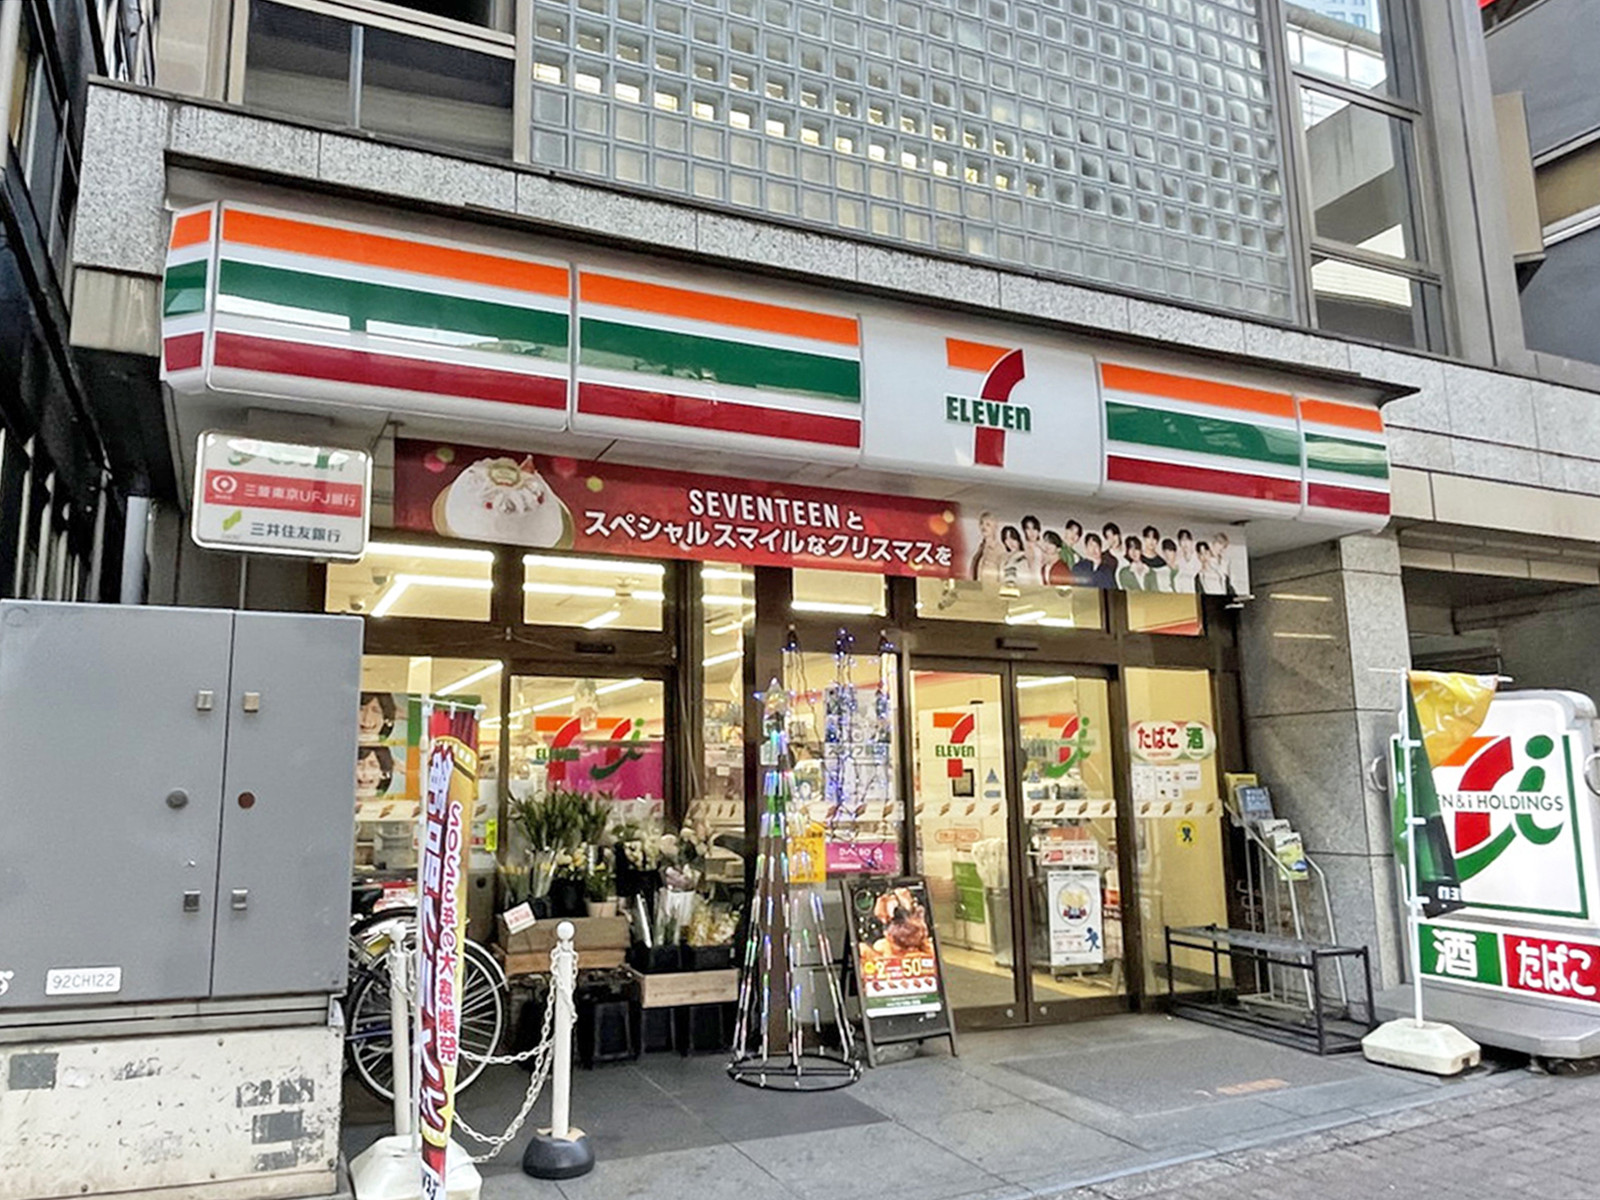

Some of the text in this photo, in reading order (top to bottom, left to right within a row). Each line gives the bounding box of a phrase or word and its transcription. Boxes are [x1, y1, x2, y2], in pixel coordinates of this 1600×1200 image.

[244, 482, 357, 508] 三菱東京UFJ銀行
[250, 521, 343, 544] 三井住友銀行
[584, 510, 952, 567] スペシャルスマイルなクリスマスを
[1137, 726, 1204, 750] たばこ 酒
[1476, 794, 1564, 812] HOLDINGS
[1431, 928, 1597, 996] 酒 たばこ
[53, 974, 115, 989] 92CH122
